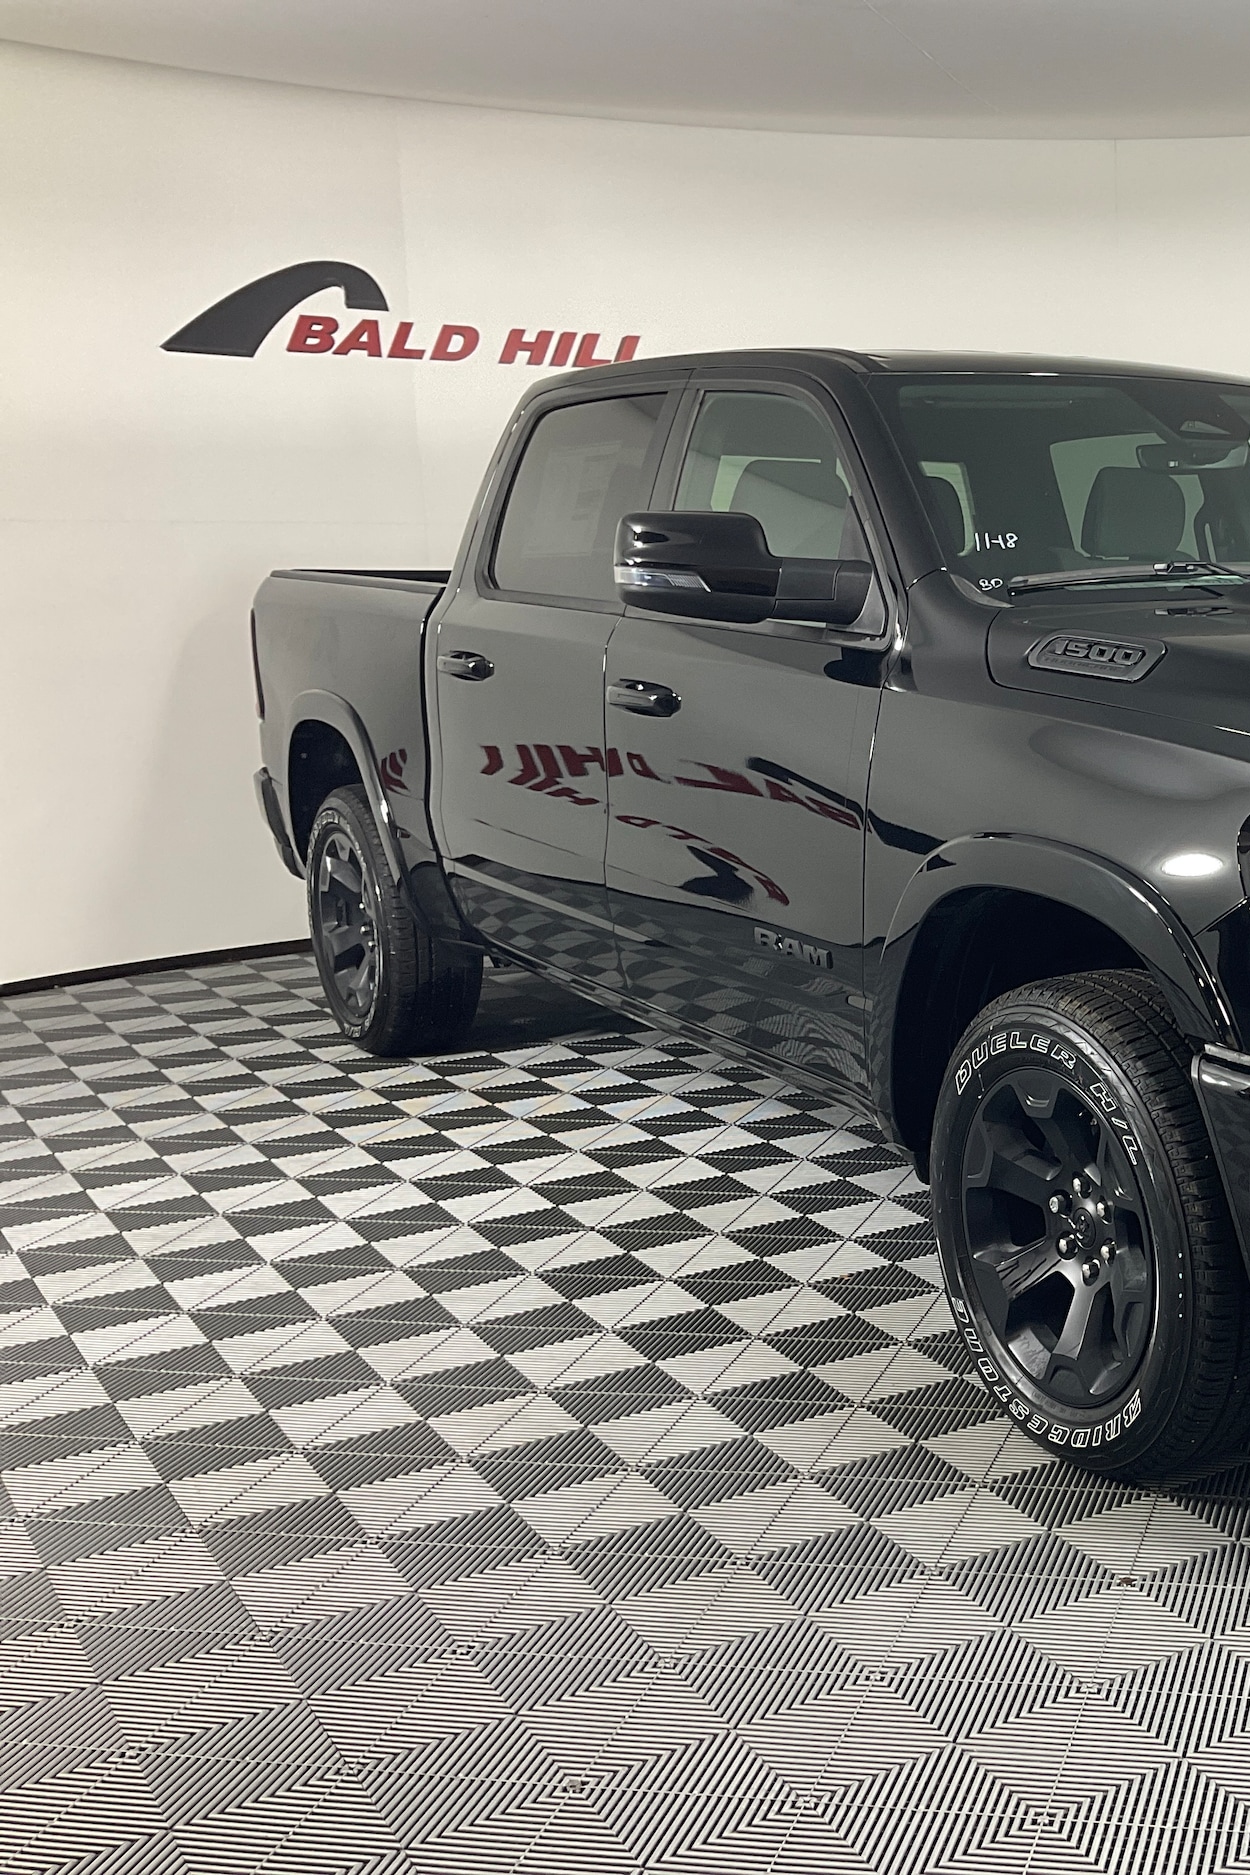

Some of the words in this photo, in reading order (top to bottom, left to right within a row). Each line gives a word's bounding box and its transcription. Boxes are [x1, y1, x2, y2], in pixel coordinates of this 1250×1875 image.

[286, 315, 479, 361] BALD
[1054, 639, 1142, 666] 1500
[754, 926, 833, 969] RAM
[955, 1031, 1076, 1096] DUELER
[951, 1297, 1142, 1448] BRIDGESTONE
